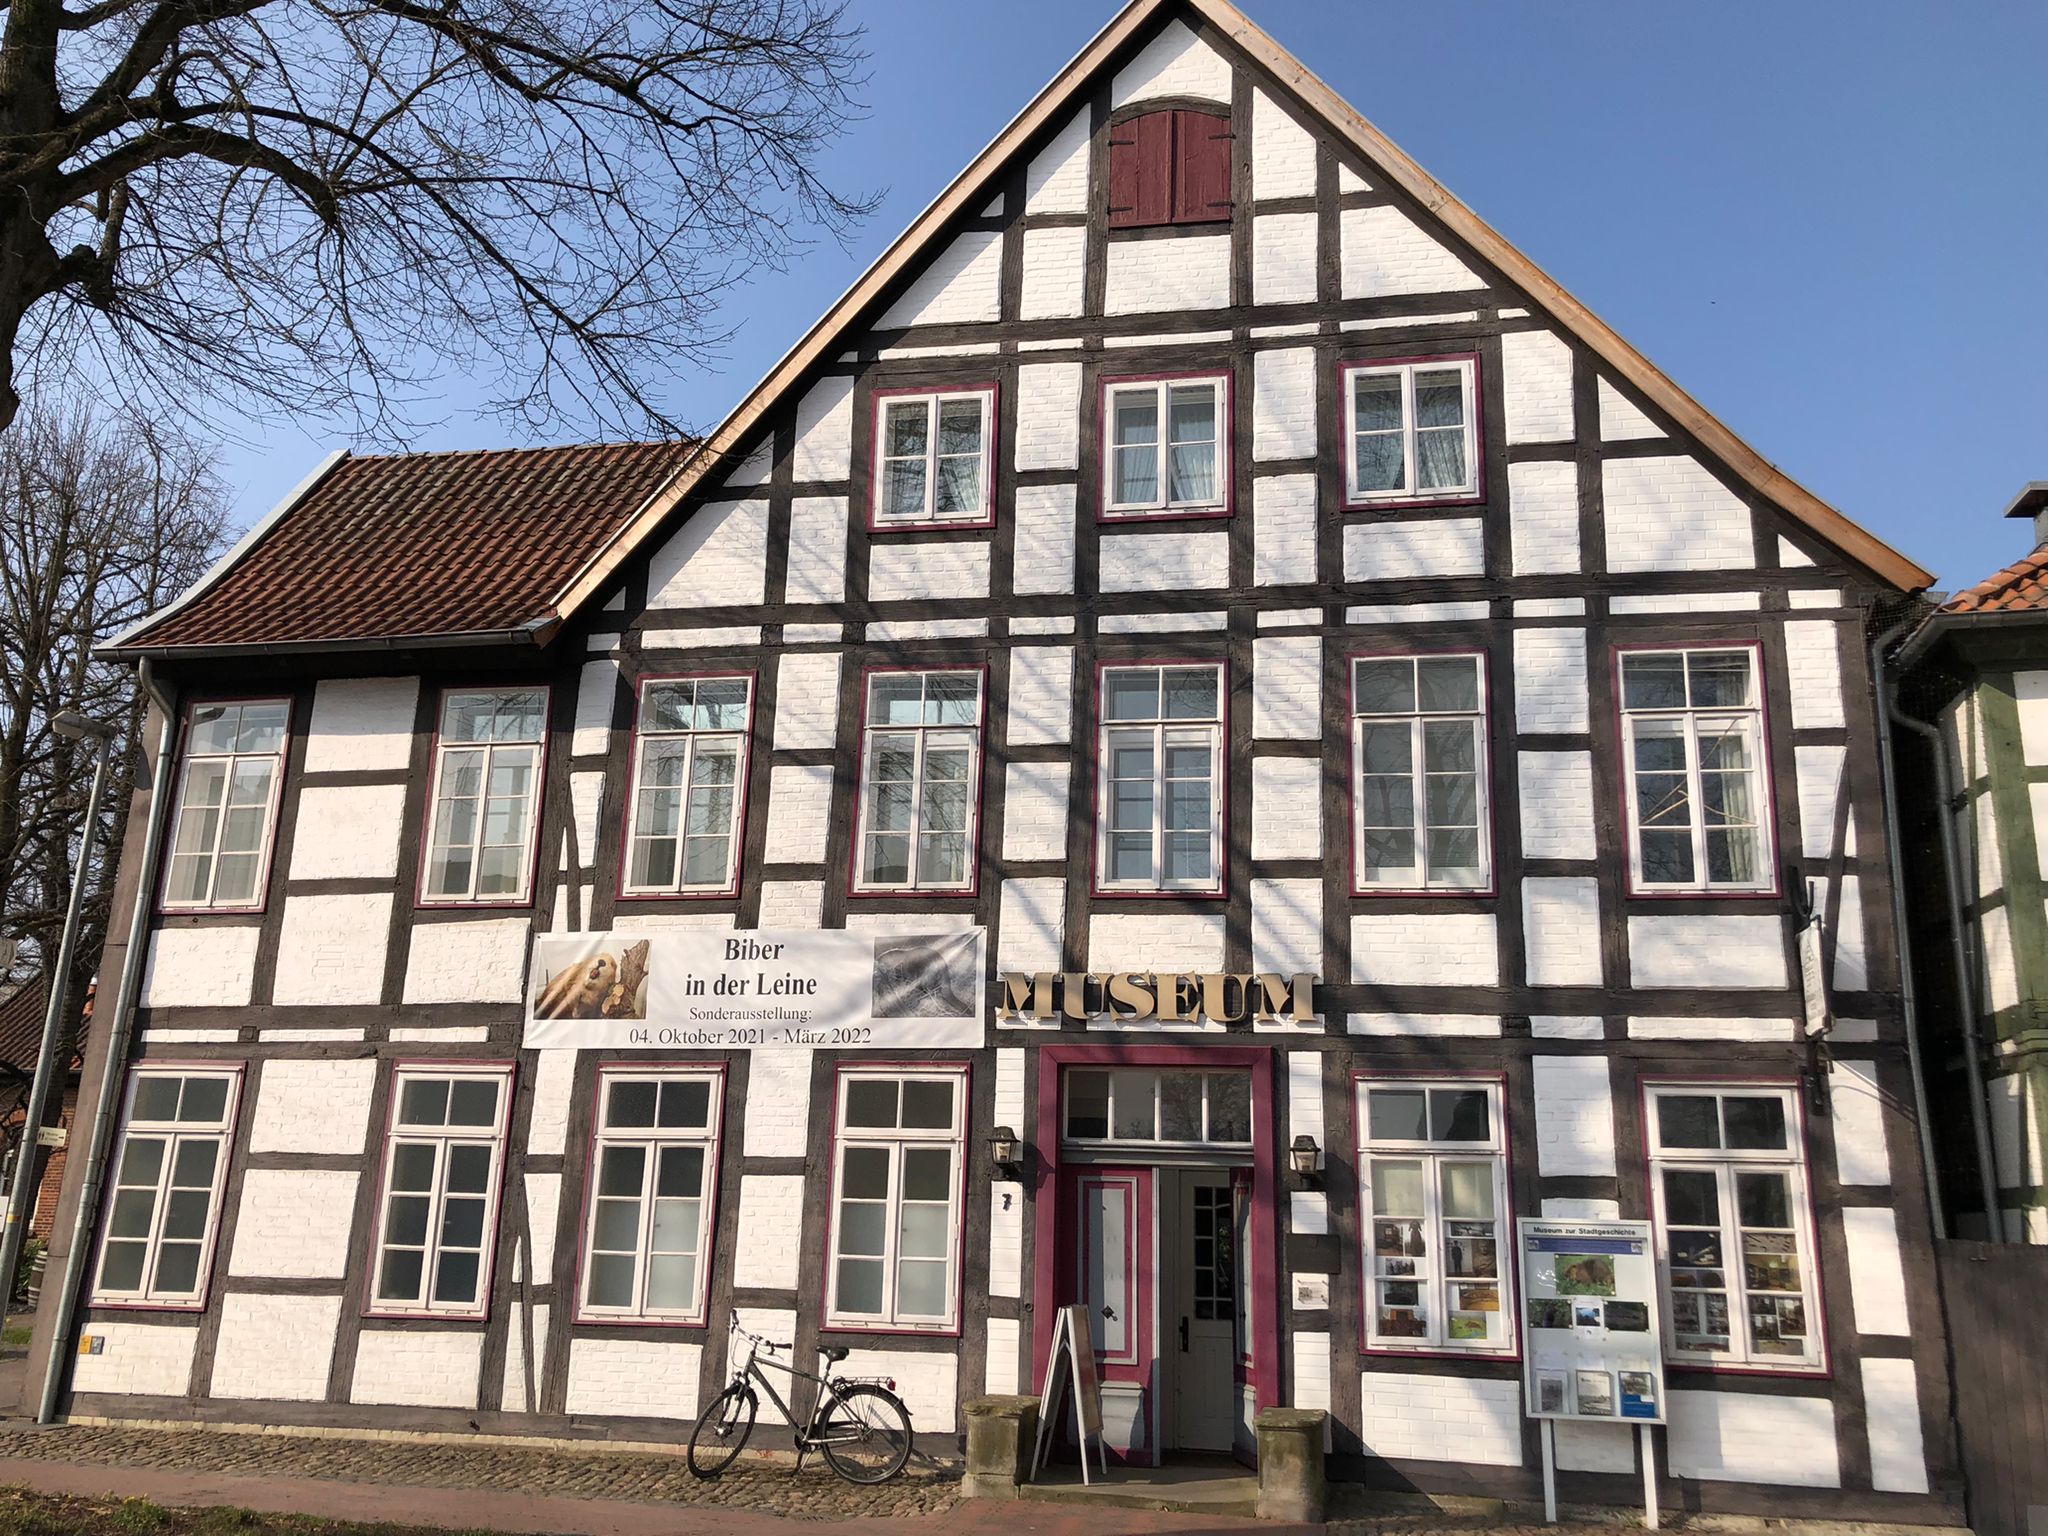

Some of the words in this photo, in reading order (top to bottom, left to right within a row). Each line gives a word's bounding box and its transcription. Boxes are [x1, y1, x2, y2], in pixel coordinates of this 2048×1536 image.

[724, 938, 784, 961] Biber
[685, 973, 706, 996] in
[713, 971, 750, 996] der
[757, 971, 817, 996] Leine
[997, 969, 1320, 1023] MUSEUM
[689, 1006, 812, 1023] Sonderausstellung:
[629, 1029, 653, 1044] 04.
[659, 1028, 723, 1044] Oktober
[728, 1028, 765, 1044] 2021
[784, 1028, 825, 1044] März
[831, 1028, 871, 1044] 2022
[1002, 1193, 1011, 1210] 7
[1533, 1226, 1562, 1234] Museum
[1578, 1227, 1636, 1236] Stadtgeschichte
